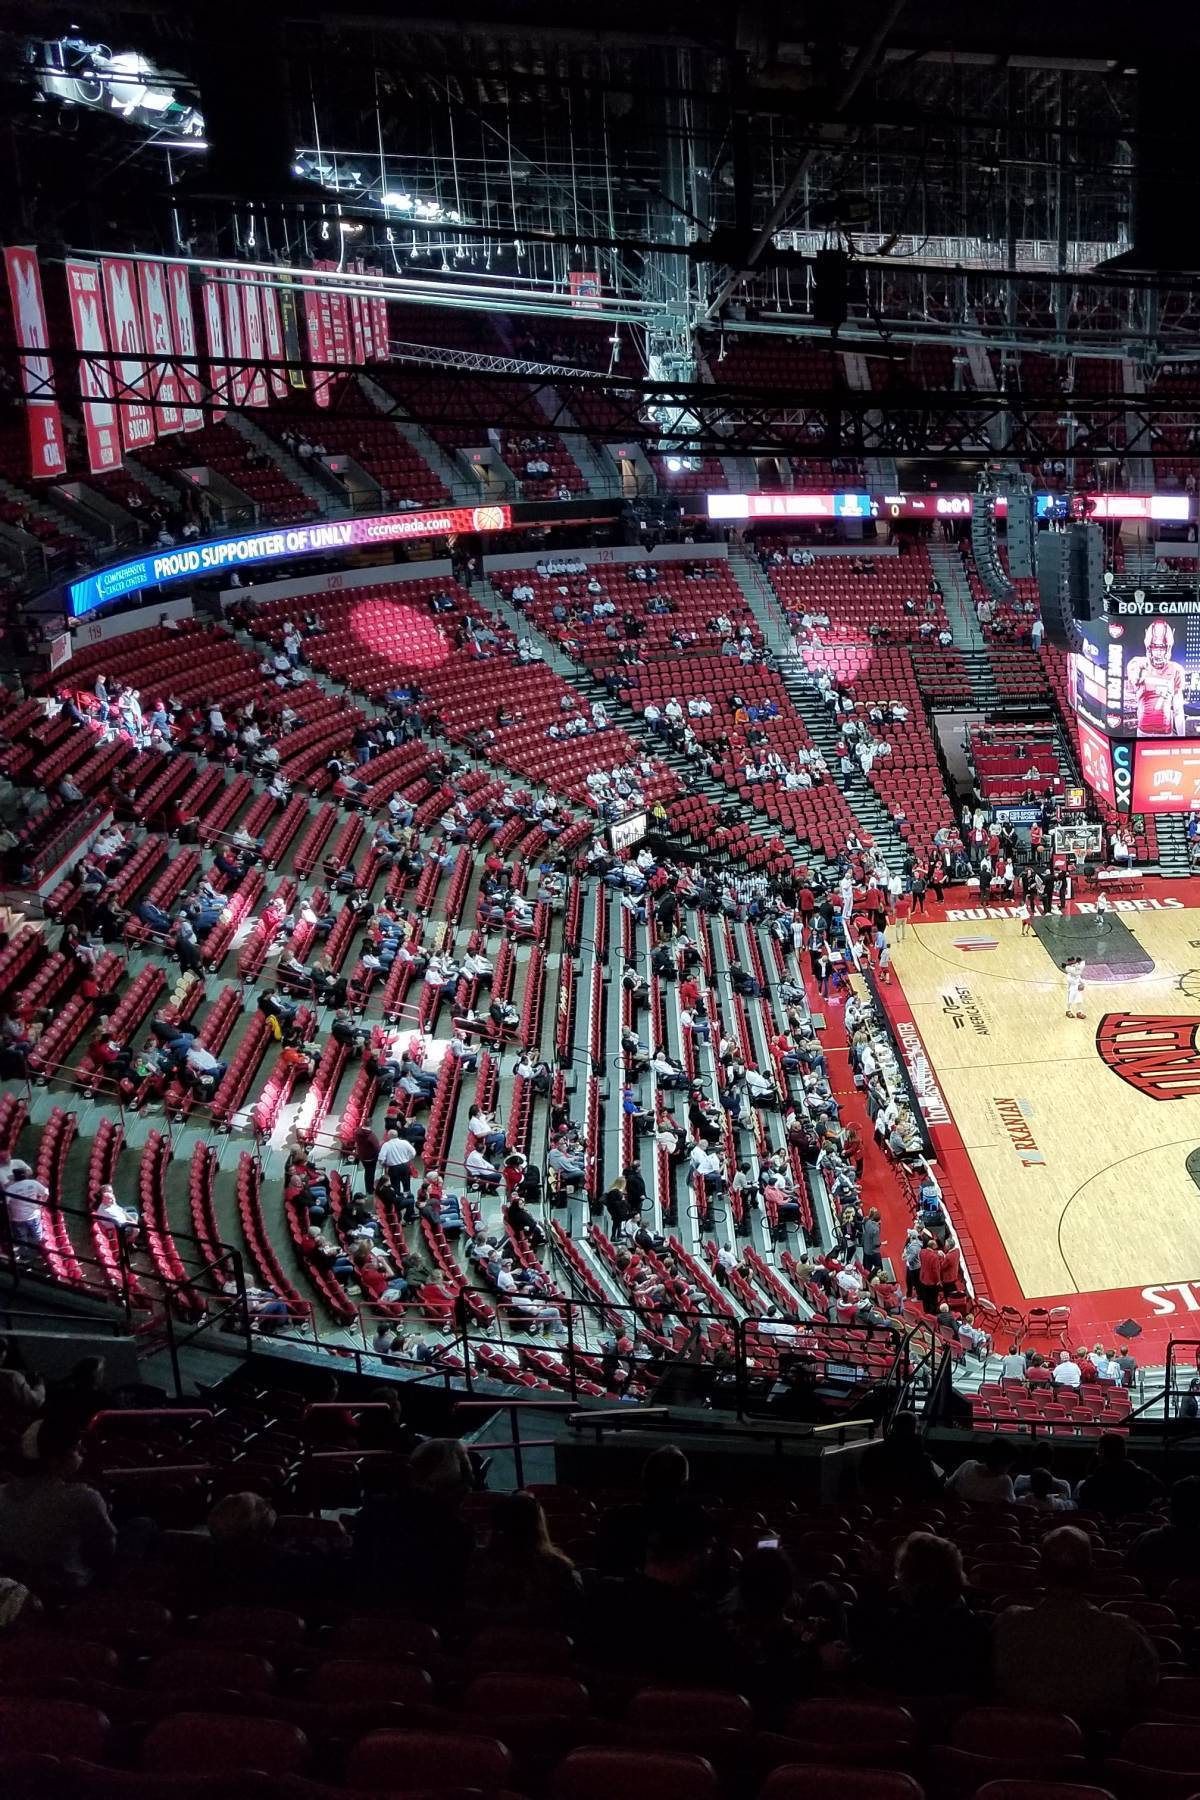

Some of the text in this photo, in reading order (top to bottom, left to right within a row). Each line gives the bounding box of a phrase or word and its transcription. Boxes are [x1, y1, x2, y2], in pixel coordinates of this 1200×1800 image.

[891, 504, 900, 517] 0
[367, 517, 451, 537] cccnevada.com
[154, 524, 352, 579] PROUD SUPPORTER OF UNLV
[104, 563, 146, 585] COMPREHENSIVE
[327, 575, 343, 588] 120
[106, 574, 147, 595] CANCER CENTERS
[1118, 602, 1154, 614] BOYD
[89, 625, 102, 640] 119
[1114, 746, 1131, 805] COX
[1153, 769, 1183, 787] UNLV
[1076, 898, 1185, 914] REBELS
[955, 986, 974, 1007] FIRST
[966, 1004, 991, 1035] AMERICA
[896, 1021, 921, 1049] CENTER
